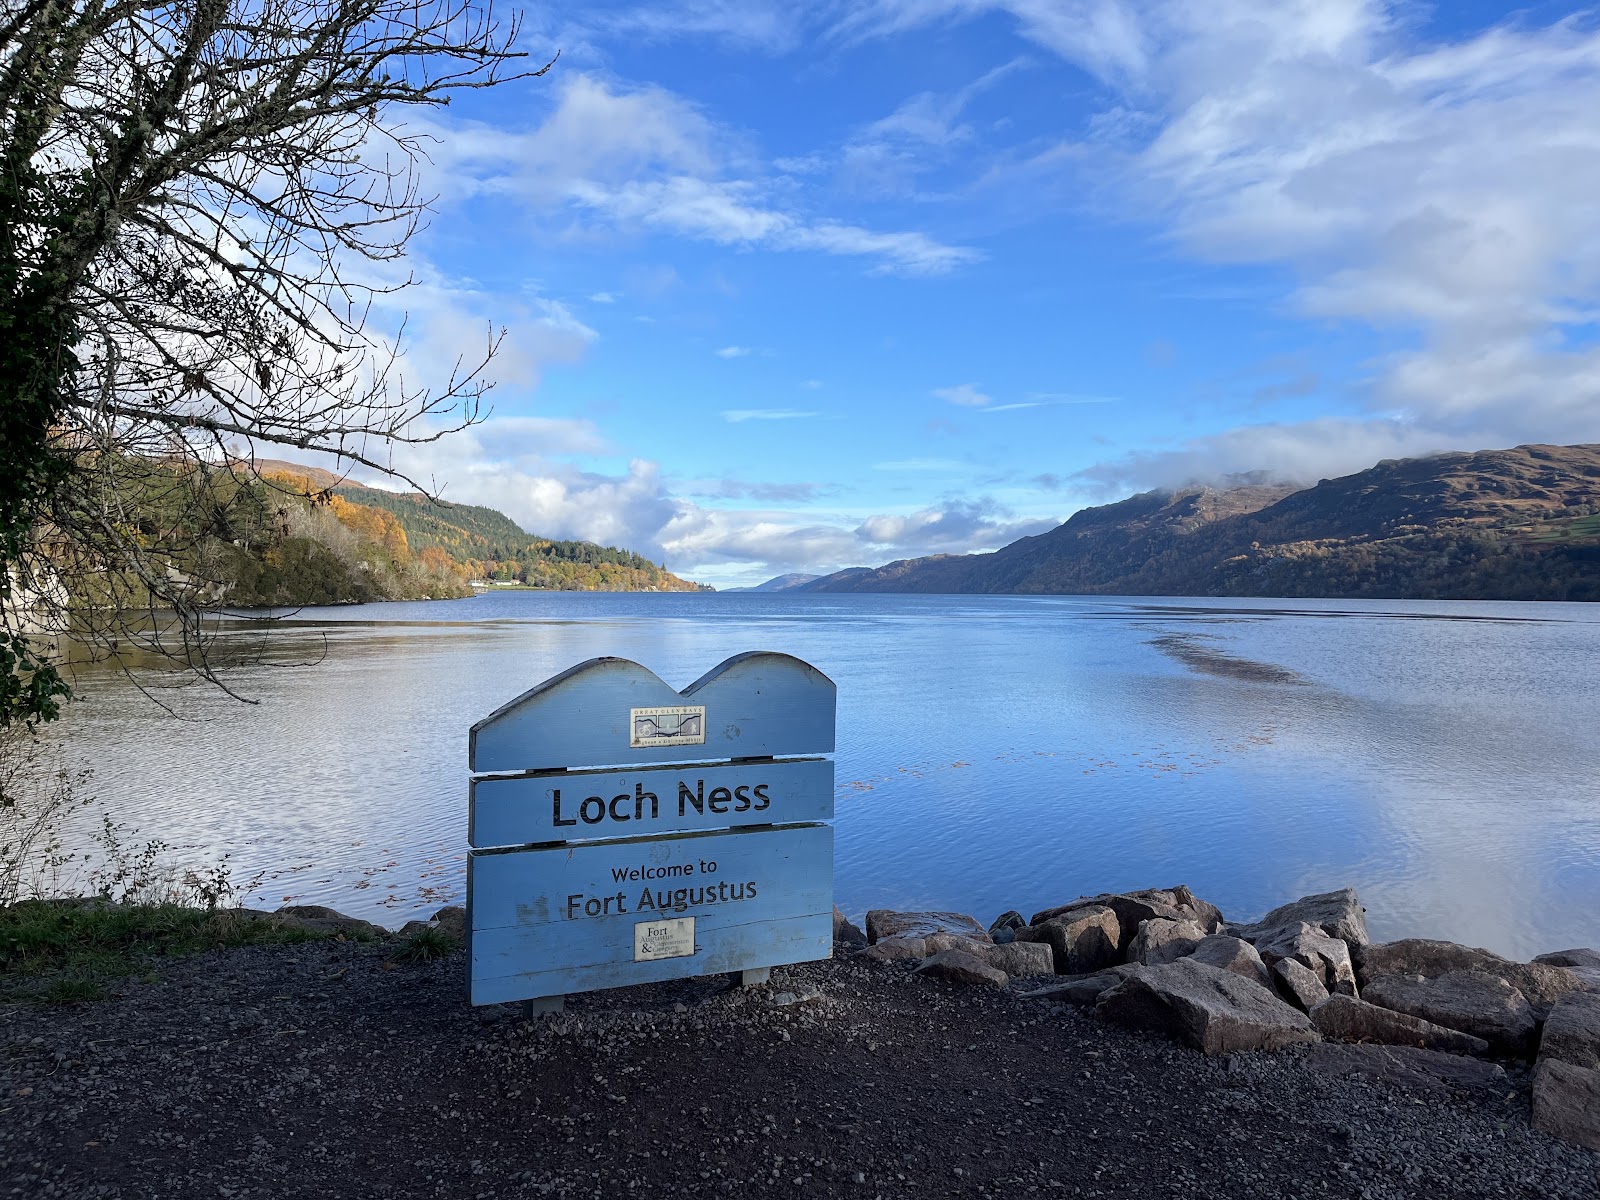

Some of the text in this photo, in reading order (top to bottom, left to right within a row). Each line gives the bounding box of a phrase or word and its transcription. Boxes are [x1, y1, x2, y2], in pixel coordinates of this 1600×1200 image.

[552, 779, 771, 827] Loch Ness
[611, 859, 717, 883] Welcome to
[567, 880, 757, 919] Fort Augustus
[640, 934, 674, 944] Augustus
[647, 927, 667, 937] Fort
[641, 942, 652, 954] &
